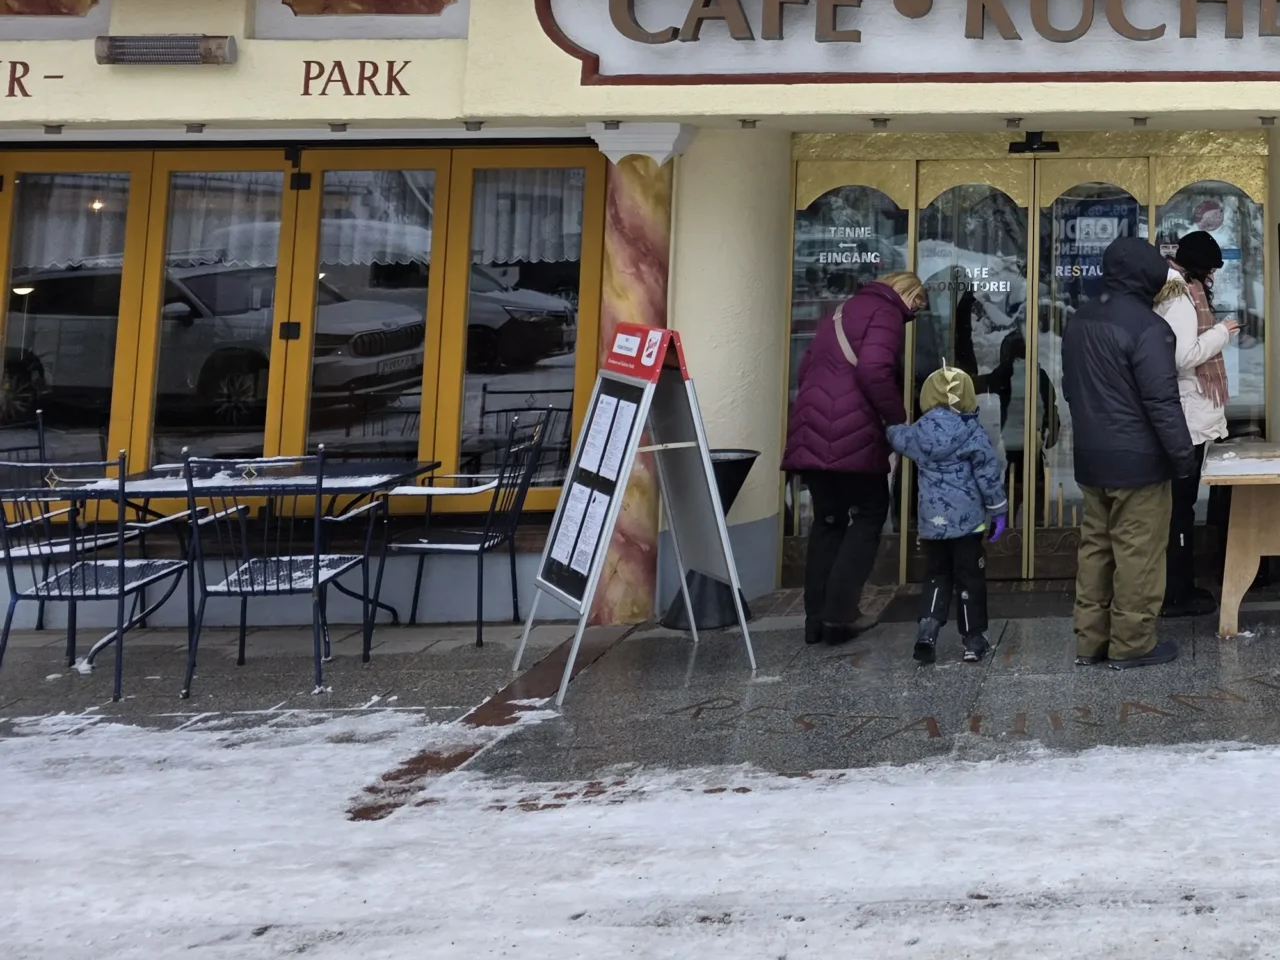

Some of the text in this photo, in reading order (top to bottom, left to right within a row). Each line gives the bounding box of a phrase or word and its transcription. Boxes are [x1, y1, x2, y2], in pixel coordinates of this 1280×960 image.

[301, 60, 411, 96] PARK
[828, 226, 872, 239] TENNE
[818, 251, 881, 263] EINGANG
[953, 267, 989, 279] CAFE
